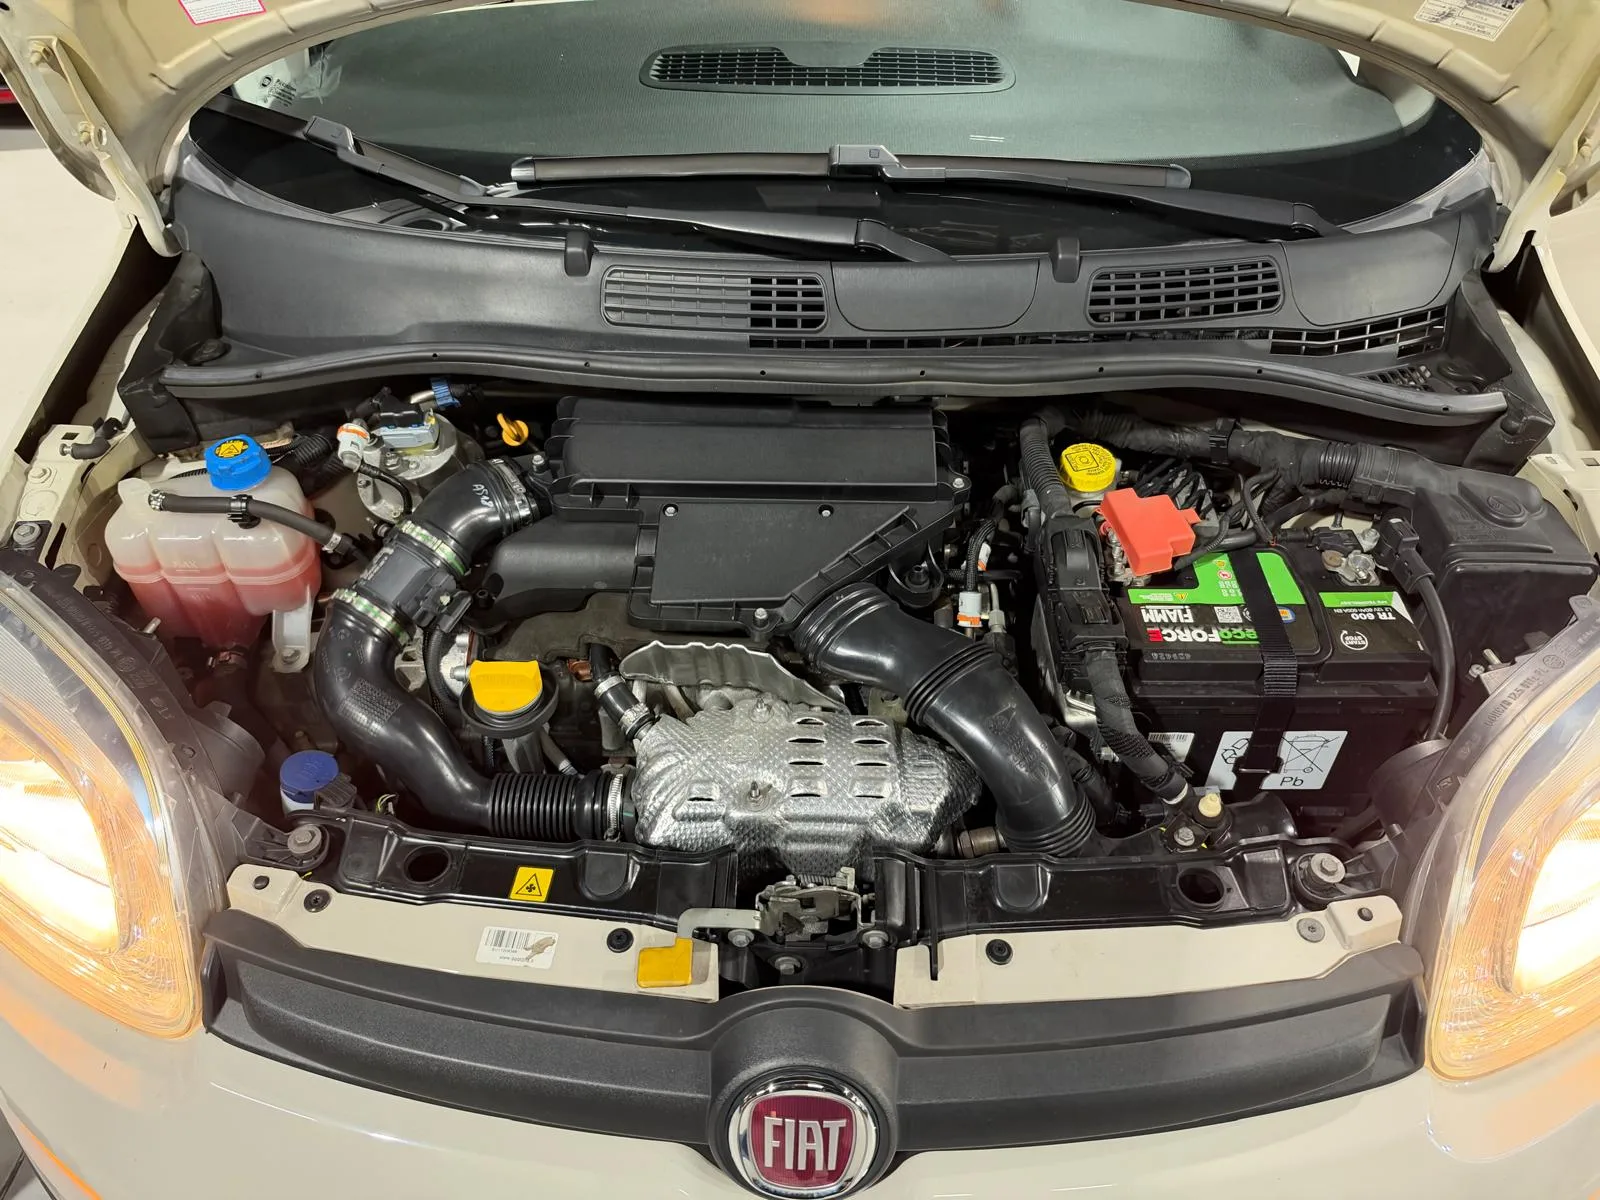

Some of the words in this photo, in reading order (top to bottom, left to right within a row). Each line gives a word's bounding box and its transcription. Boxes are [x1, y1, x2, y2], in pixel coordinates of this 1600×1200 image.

[1140, 608, 1194, 623] FIAMM
[1350, 612, 1375, 620] 600
[1379, 612, 1396, 620] TR
[1279, 776, 1304, 787] Pb
[764, 1116, 847, 1171] FIAT
